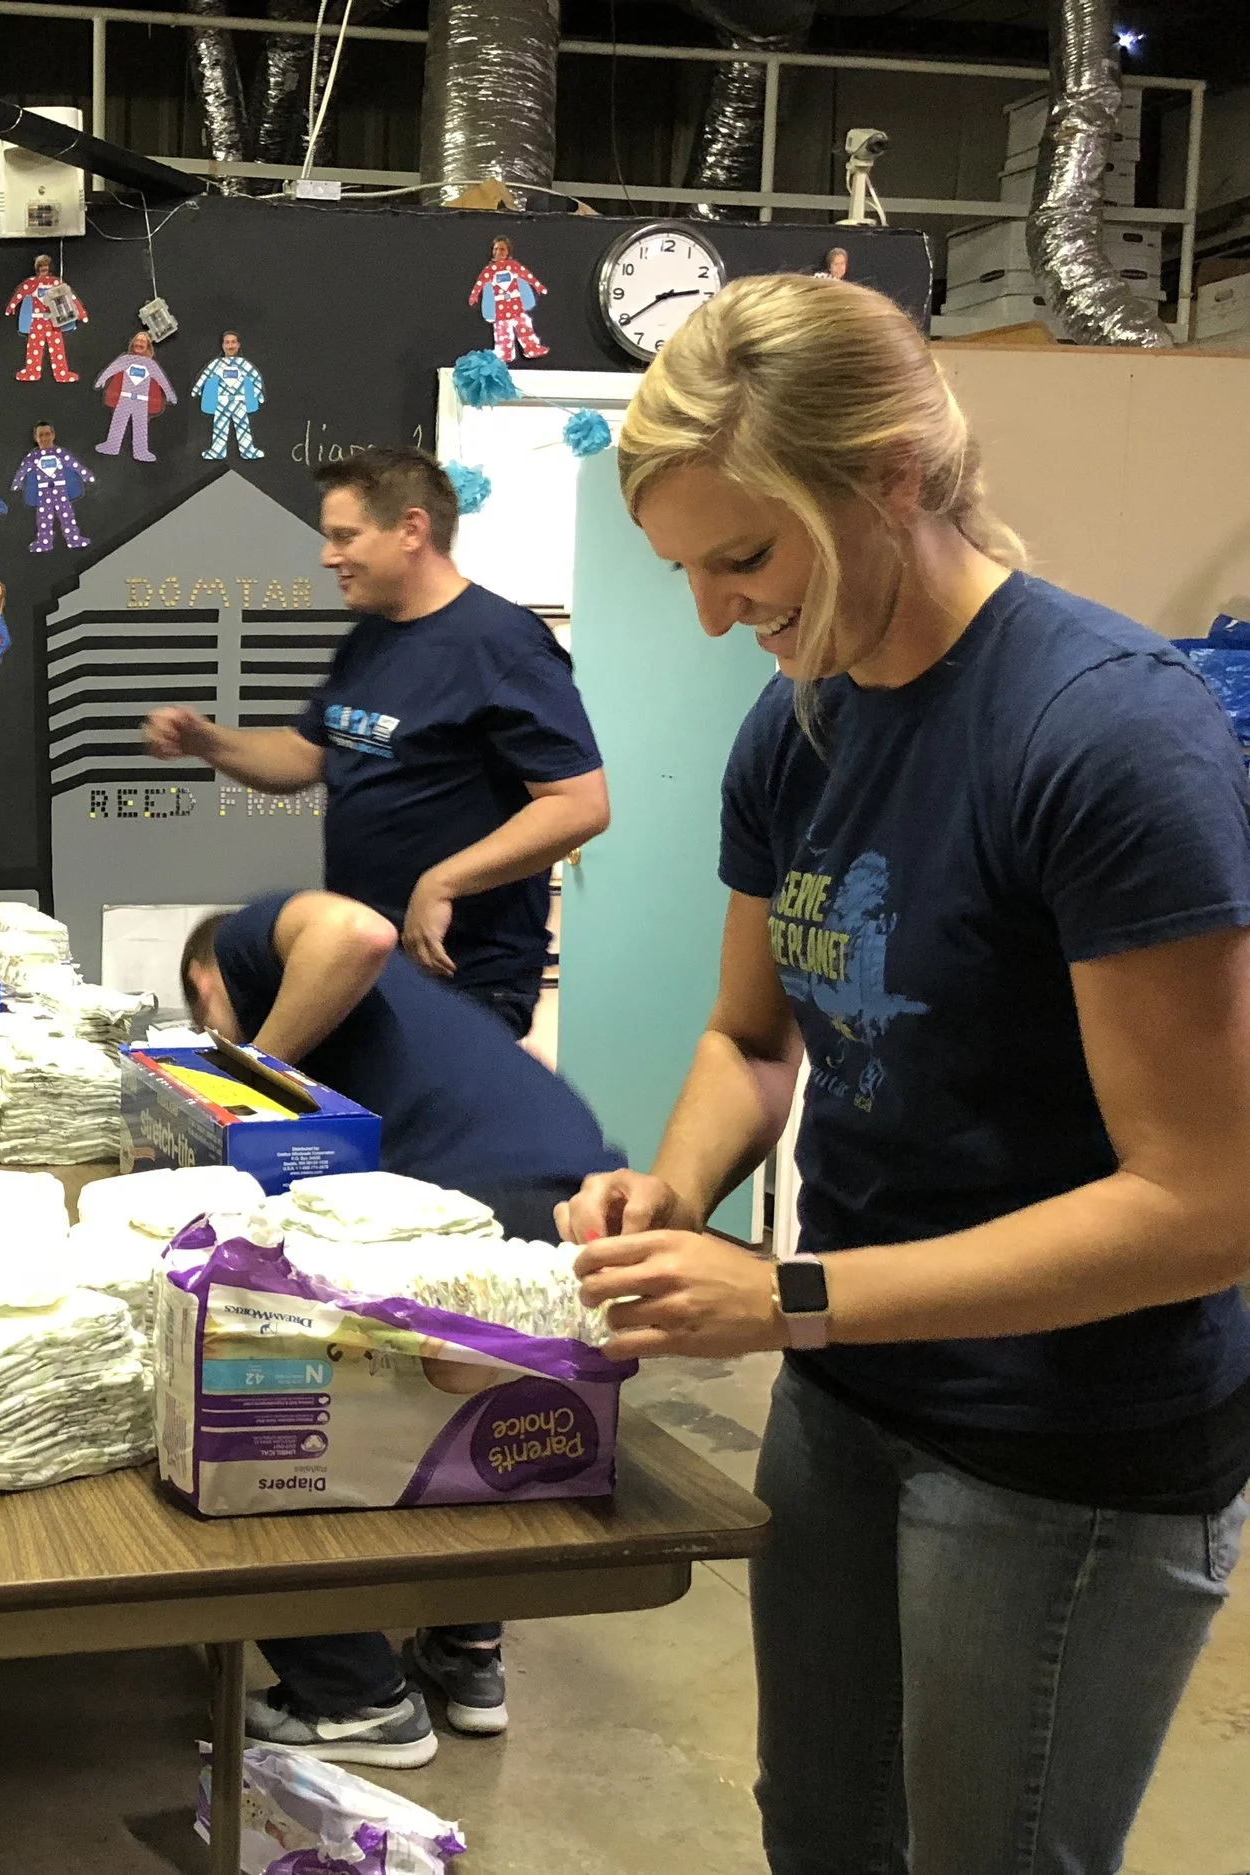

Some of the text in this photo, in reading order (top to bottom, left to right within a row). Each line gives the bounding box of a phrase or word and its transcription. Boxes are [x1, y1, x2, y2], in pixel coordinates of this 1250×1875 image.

[661, 240, 676, 252] 12
[687, 246, 692, 259] 1
[622, 263, 635, 276] 10
[697, 266, 710, 279] 2
[613, 287, 625, 300] 9
[618, 313, 631, 327] 8
[634, 332, 645, 345] 7
[125, 577, 312, 608] DOMTAR
[90, 786, 197, 818] REED
[776, 871, 832, 923] SERVE
[787, 924, 850, 982] PLANET
[141, 1107, 196, 1167] stretch-tite
[245, 1372, 265, 1385] 42
[305, 1364, 324, 1384] N
[492, 1407, 575, 1439] Choice
[489, 1432, 586, 1475] Parent's
[258, 1476, 327, 1491] Diapers
